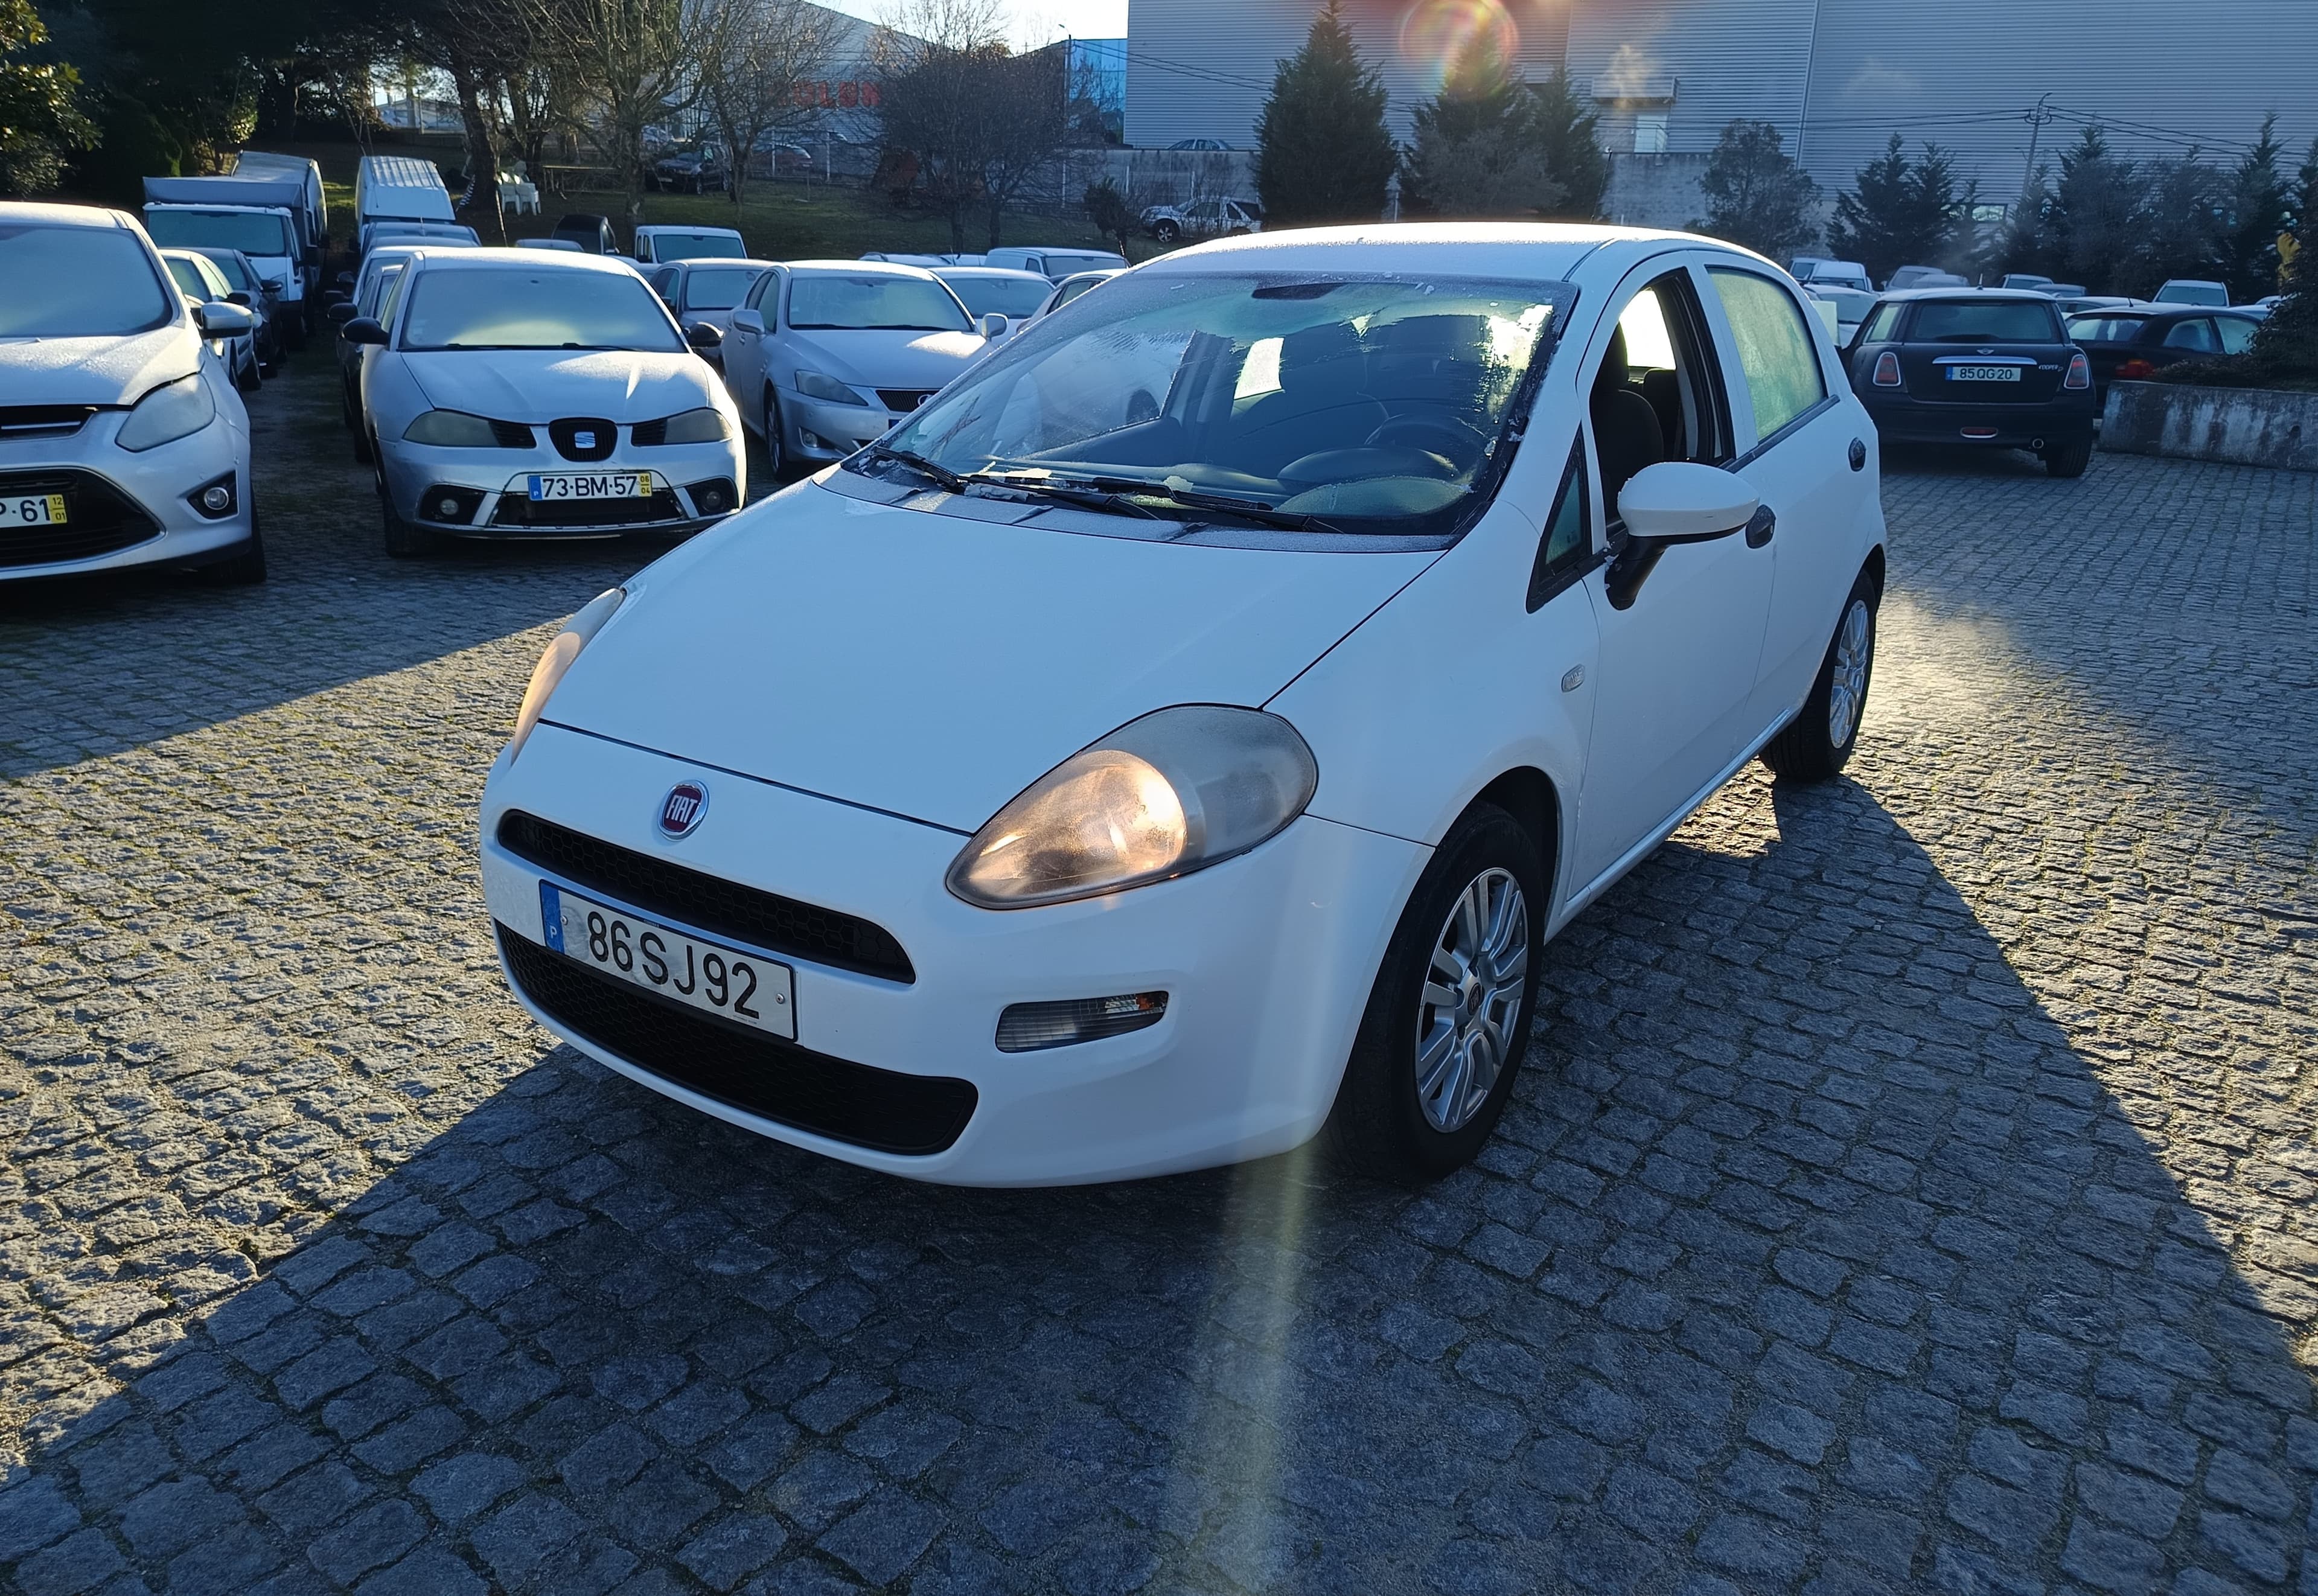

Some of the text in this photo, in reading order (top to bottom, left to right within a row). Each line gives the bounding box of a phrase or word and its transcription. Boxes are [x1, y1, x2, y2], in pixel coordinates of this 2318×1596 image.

[53, 497, 63, 505] 12
[55, 512, 66, 521] 01
[666, 794, 698, 823] FIAT
[550, 925, 558, 939] P
[587, 911, 760, 1020] 86SJ92
